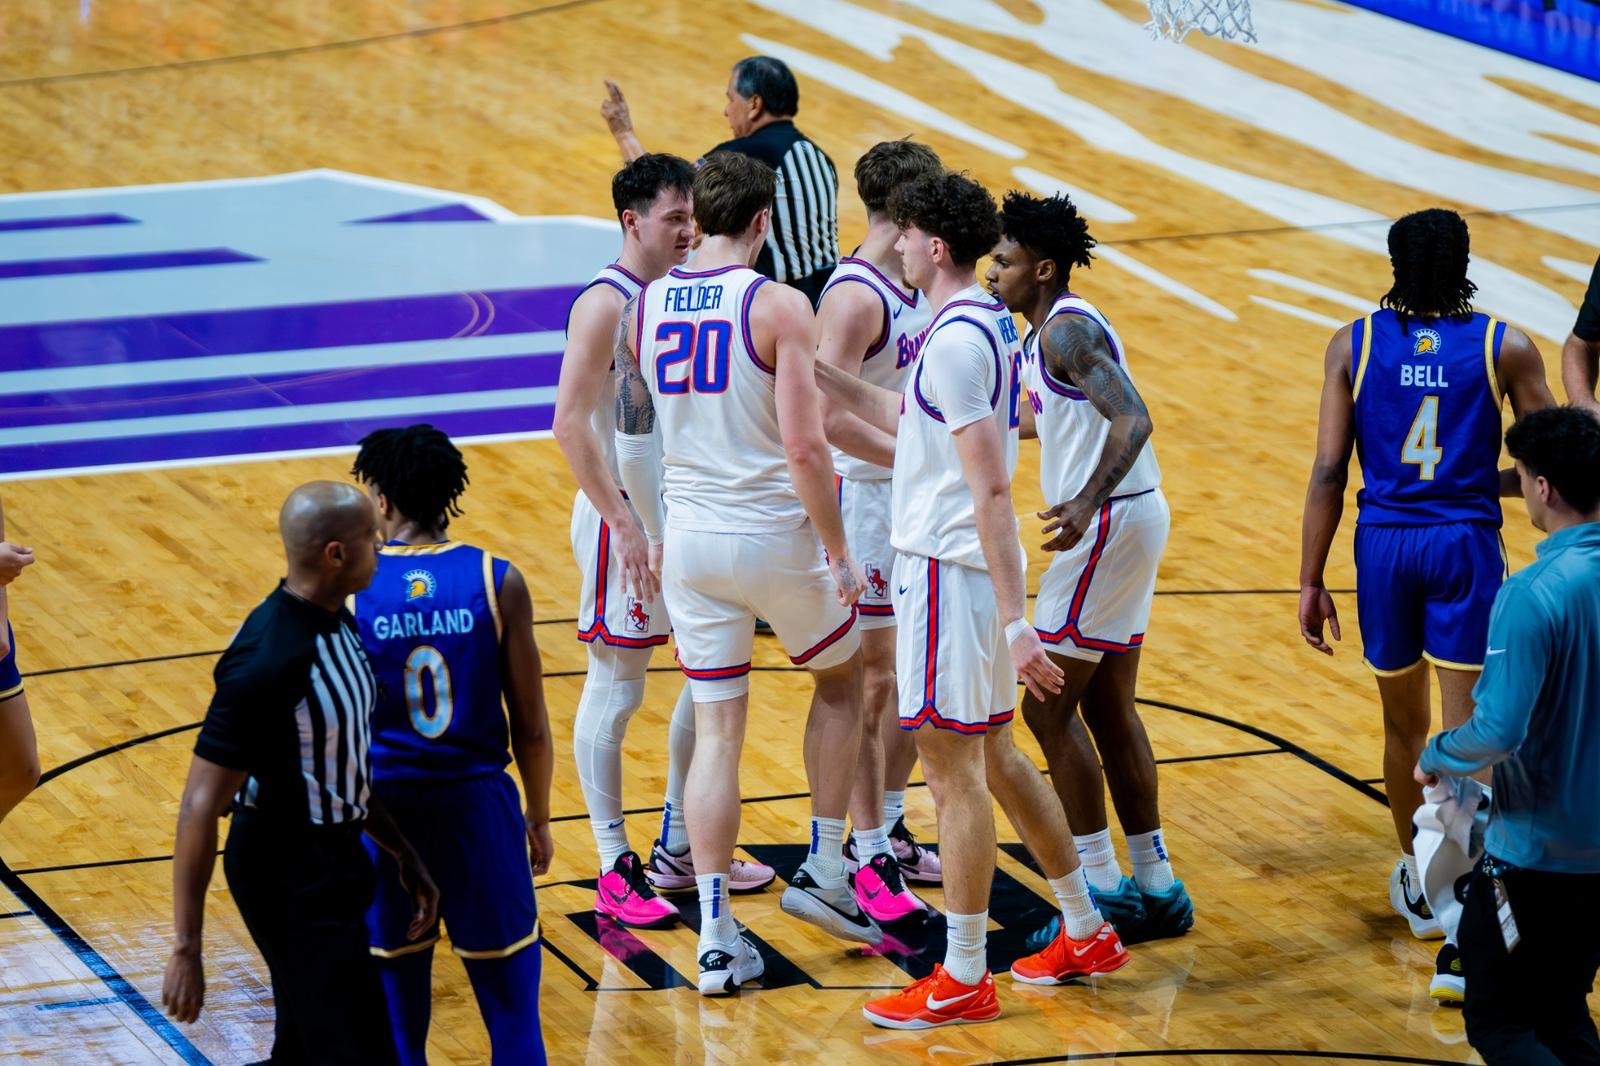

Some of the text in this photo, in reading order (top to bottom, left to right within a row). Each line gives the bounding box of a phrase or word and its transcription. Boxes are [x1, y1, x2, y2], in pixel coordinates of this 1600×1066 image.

[664, 284, 724, 312] FIELDER
[655, 319, 733, 395] 20
[1400, 364, 1449, 388] BELL
[1401, 395, 1443, 481] 4
[374, 608, 474, 640] GARLAND
[403, 645, 454, 740] 0
